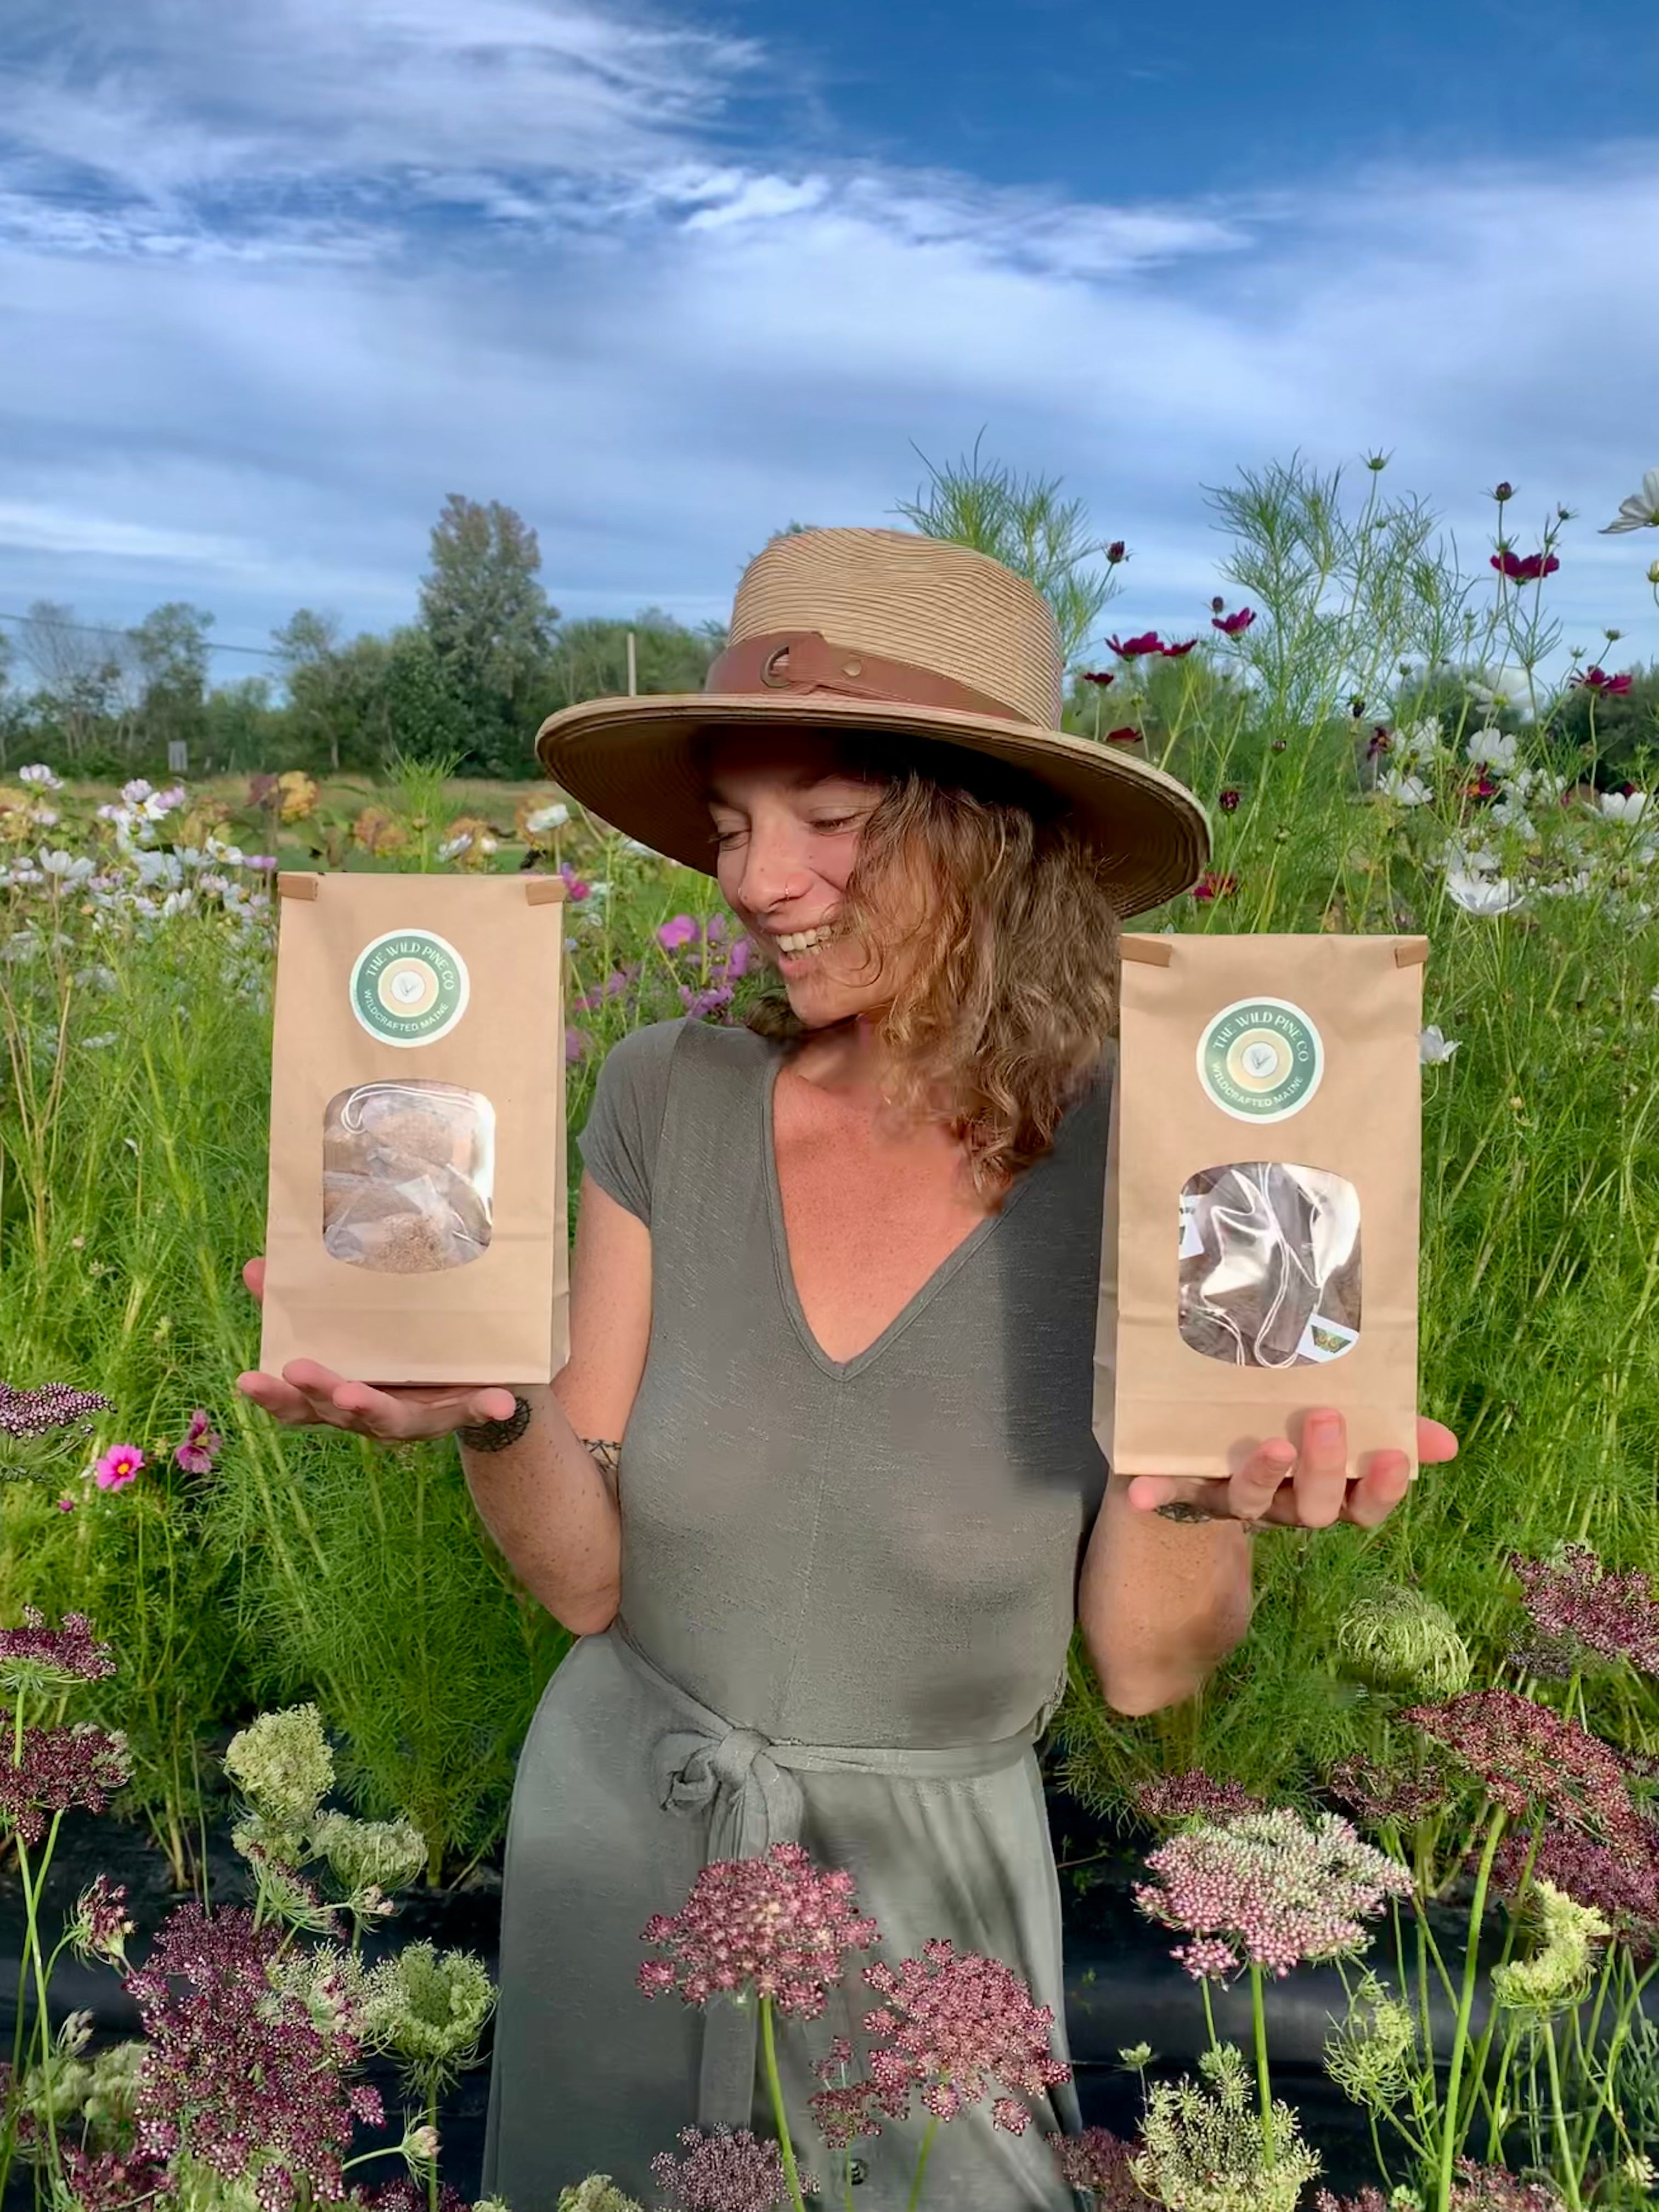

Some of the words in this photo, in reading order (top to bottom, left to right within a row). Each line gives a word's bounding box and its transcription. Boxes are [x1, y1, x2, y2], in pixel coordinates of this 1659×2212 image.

[365, 952, 387, 977] THE
[386, 941, 421, 956] WILD
[422, 946, 448, 969] PINE
[442, 970, 455, 990] CO
[364, 989, 419, 1032] WILDCRAFTED
[420, 1002, 449, 1029] MAINE
[1213, 1023, 1237, 1049] THE
[1234, 1012, 1273, 1027] WILD
[1274, 1015, 1303, 1041] PINE
[1296, 1040, 1308, 1062] CO
[1211, 1062, 1273, 1108] WILDCRAFTED
[1273, 1076, 1304, 1104] MAINE
